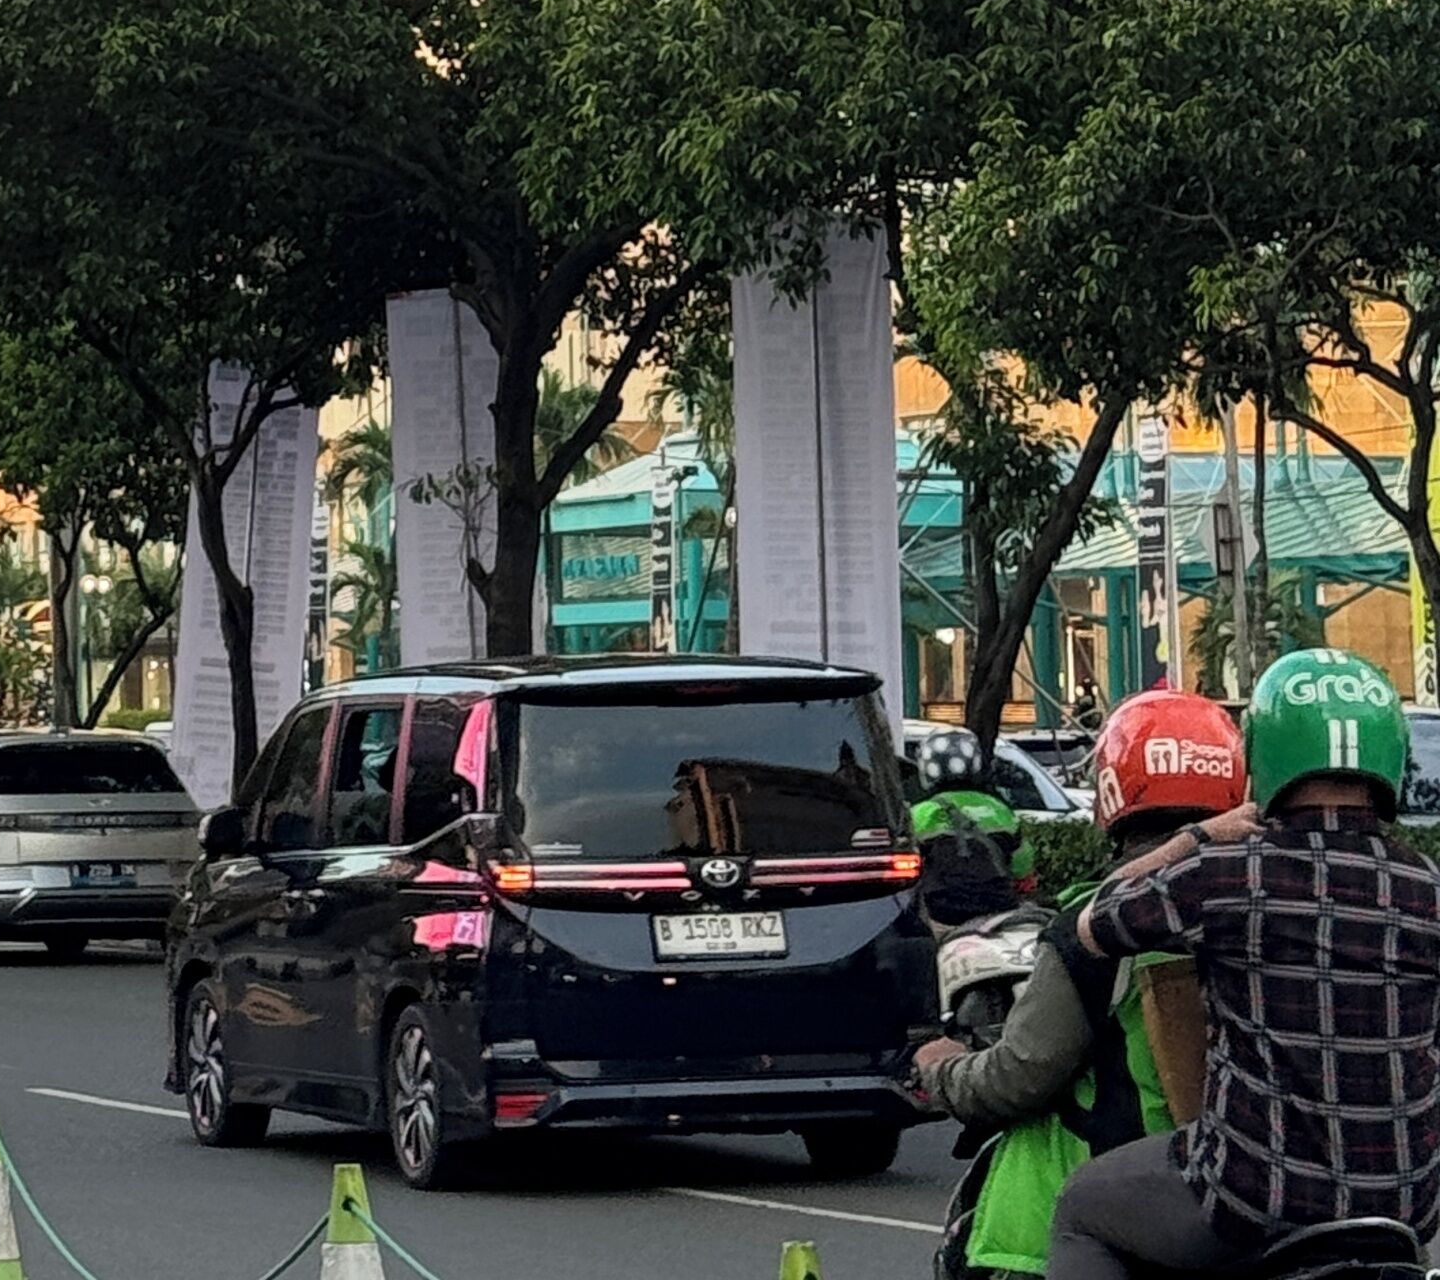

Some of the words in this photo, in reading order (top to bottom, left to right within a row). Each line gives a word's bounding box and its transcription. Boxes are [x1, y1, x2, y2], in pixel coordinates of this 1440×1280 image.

[1283, 668, 1394, 707] Grab
[1180, 754, 1234, 779] Food
[659, 918, 673, 942] B
